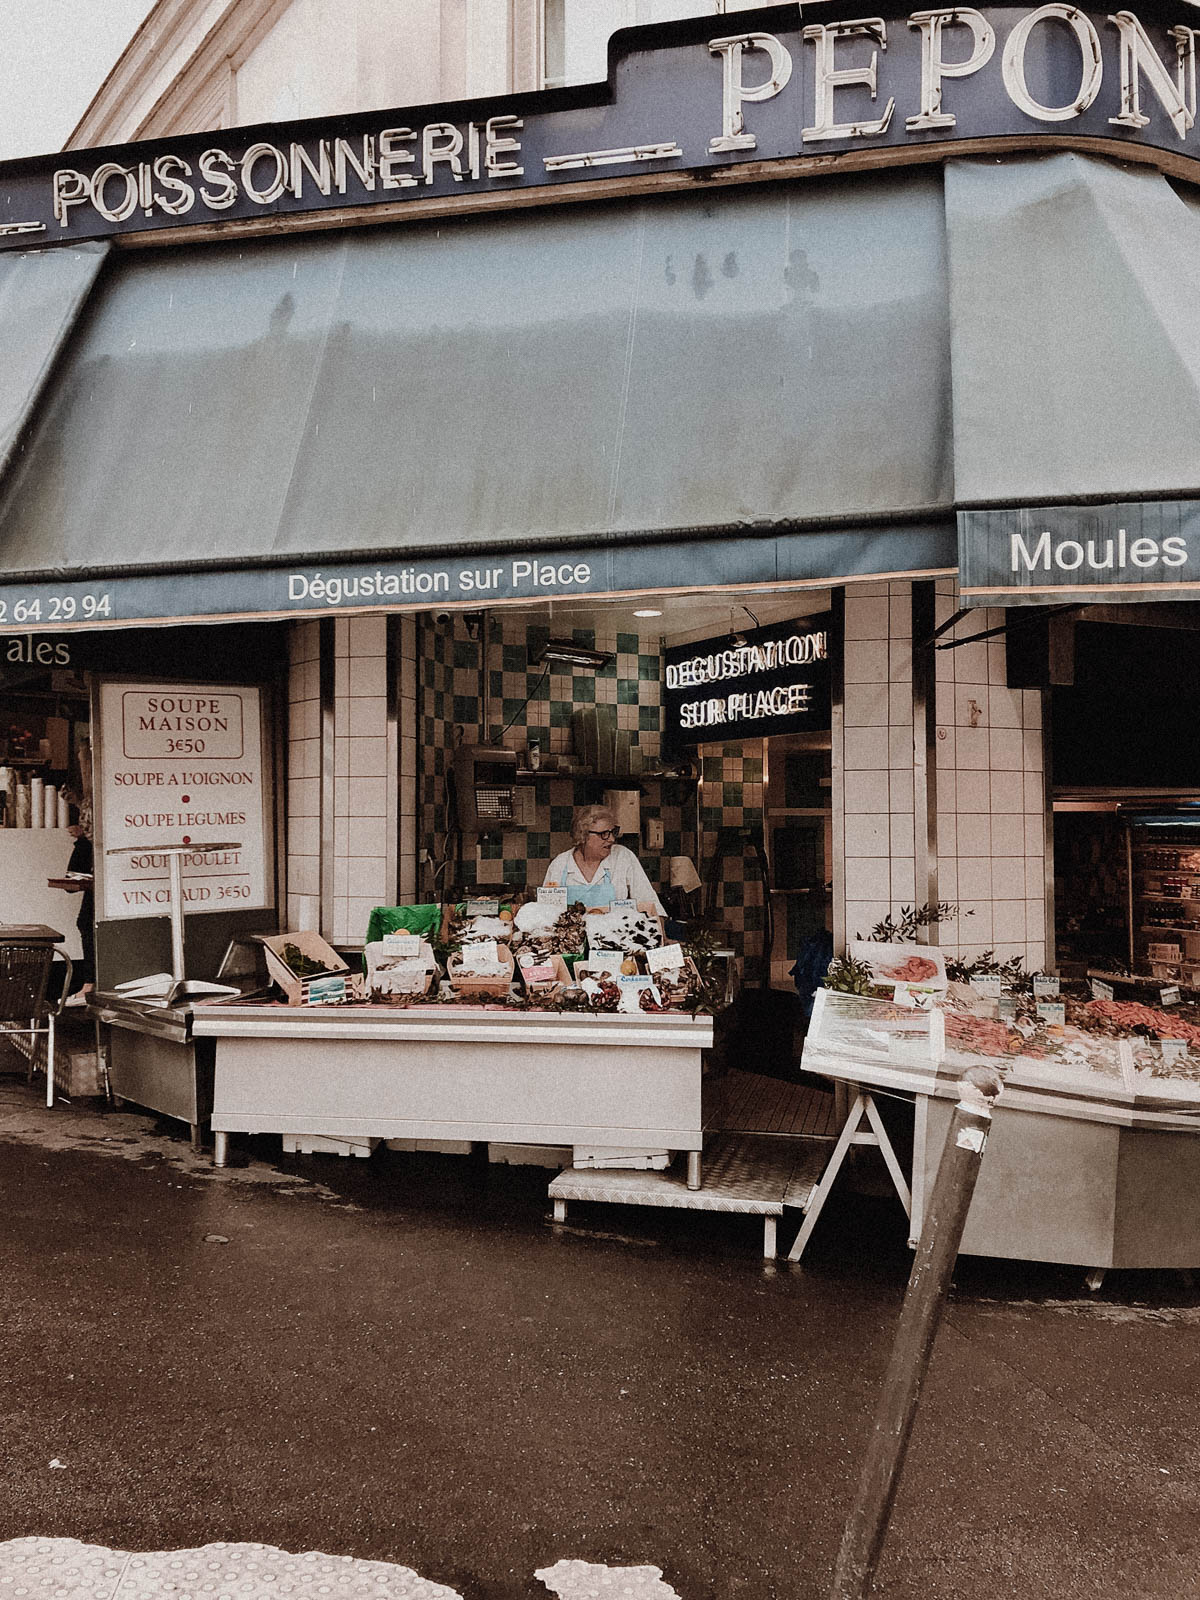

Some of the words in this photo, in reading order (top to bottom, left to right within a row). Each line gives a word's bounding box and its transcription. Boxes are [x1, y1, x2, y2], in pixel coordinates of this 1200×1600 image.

[707, 3, 1200, 153] PEPON
[52, 115, 525, 228] POISSONNERIE
[1011, 529, 1188, 572] Moules
[288, 568, 450, 605] Dégustation
[459, 569, 503, 591] sur
[512, 560, 591, 587] Place
[13, 598, 42, 622] 64
[48, 596, 77, 620] 29
[82, 594, 112, 618] 94
[666, 631, 828, 690] DEGUSTATION
[147, 698, 221, 714] SOUPE
[680, 698, 727, 729] SUR
[728, 683, 814, 722] PLACE
[138, 716, 229, 732] MAISON
[164, 738, 206, 754] 3€50
[114, 772, 165, 787] SOUPE
[167, 773, 180, 786] A
[182, 771, 254, 786] L'OIGNON
[124, 813, 174, 828] SOUPE
[177, 811, 247, 827] LEGUMES
[183, 851, 242, 867] POULET
[122, 891, 152, 905] VIN
[216, 885, 252, 900] 3€50
